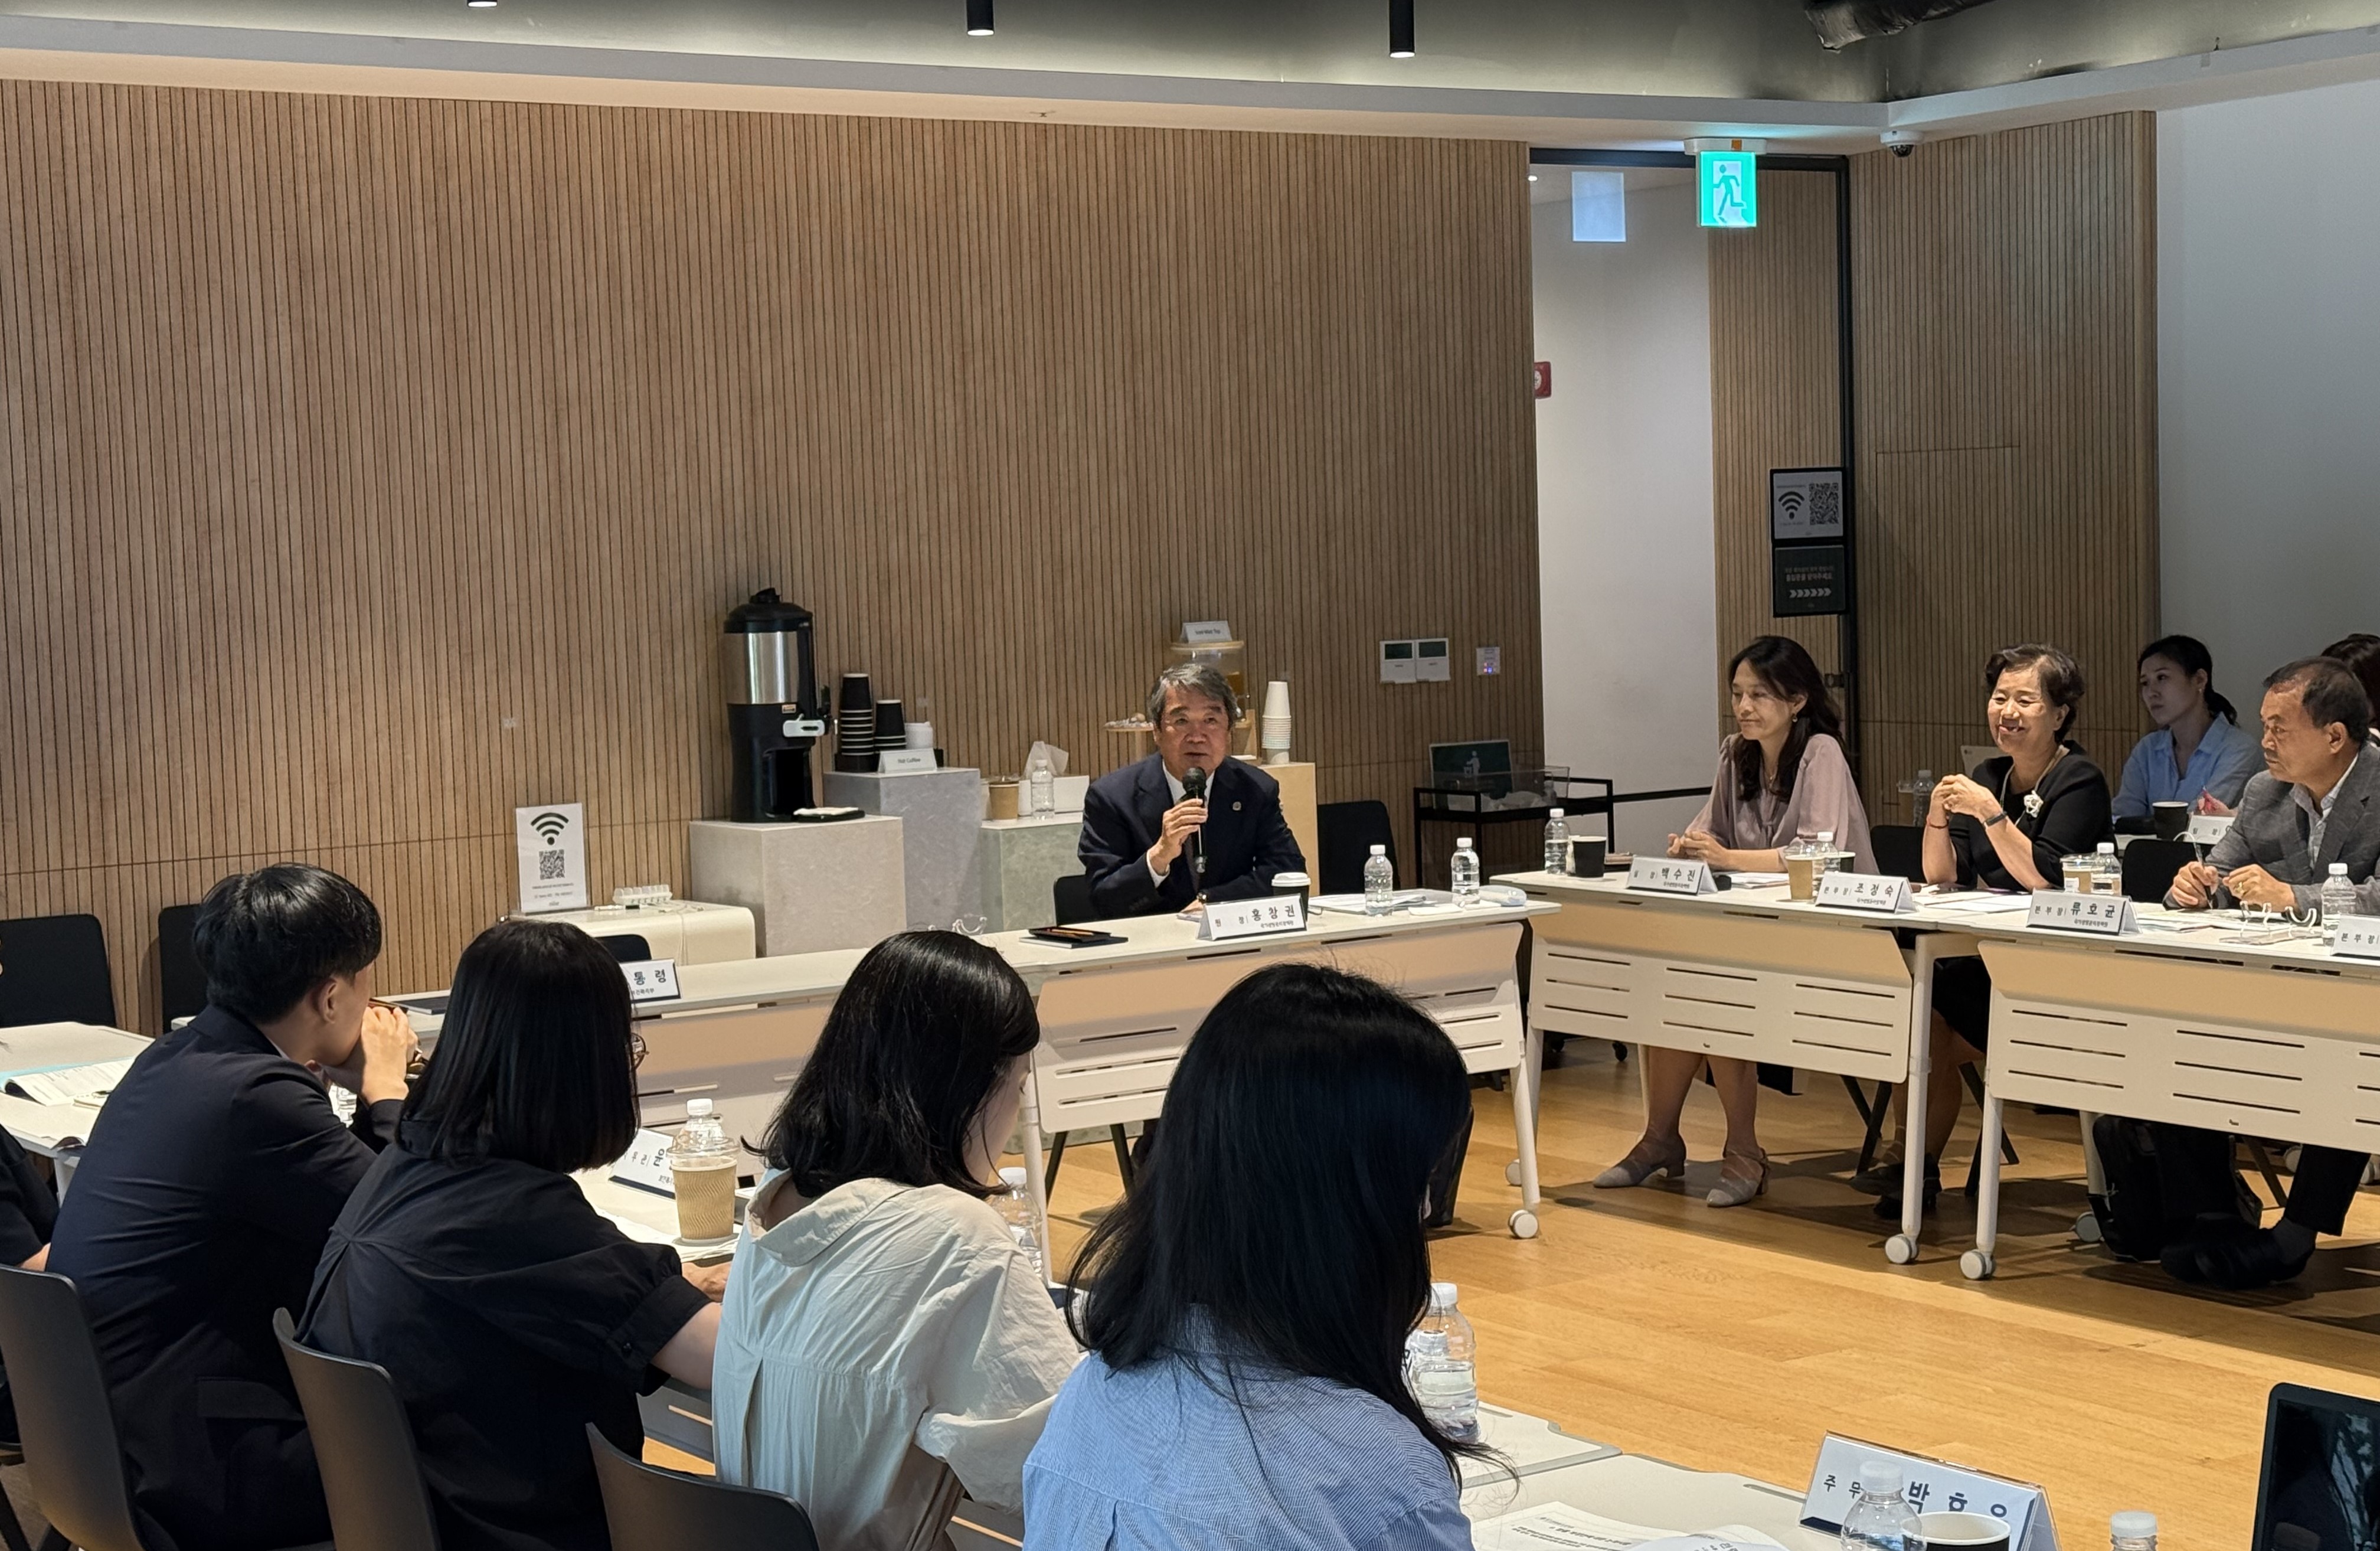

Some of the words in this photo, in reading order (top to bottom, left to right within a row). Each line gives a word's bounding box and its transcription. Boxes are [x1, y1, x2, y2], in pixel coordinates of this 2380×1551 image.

[1662, 868, 1695, 882] 백수진
[1854, 883, 1894, 898] 조정숙
[1251, 905, 1295, 922] 홍창권
[2071, 902, 2115, 918] 류호균
